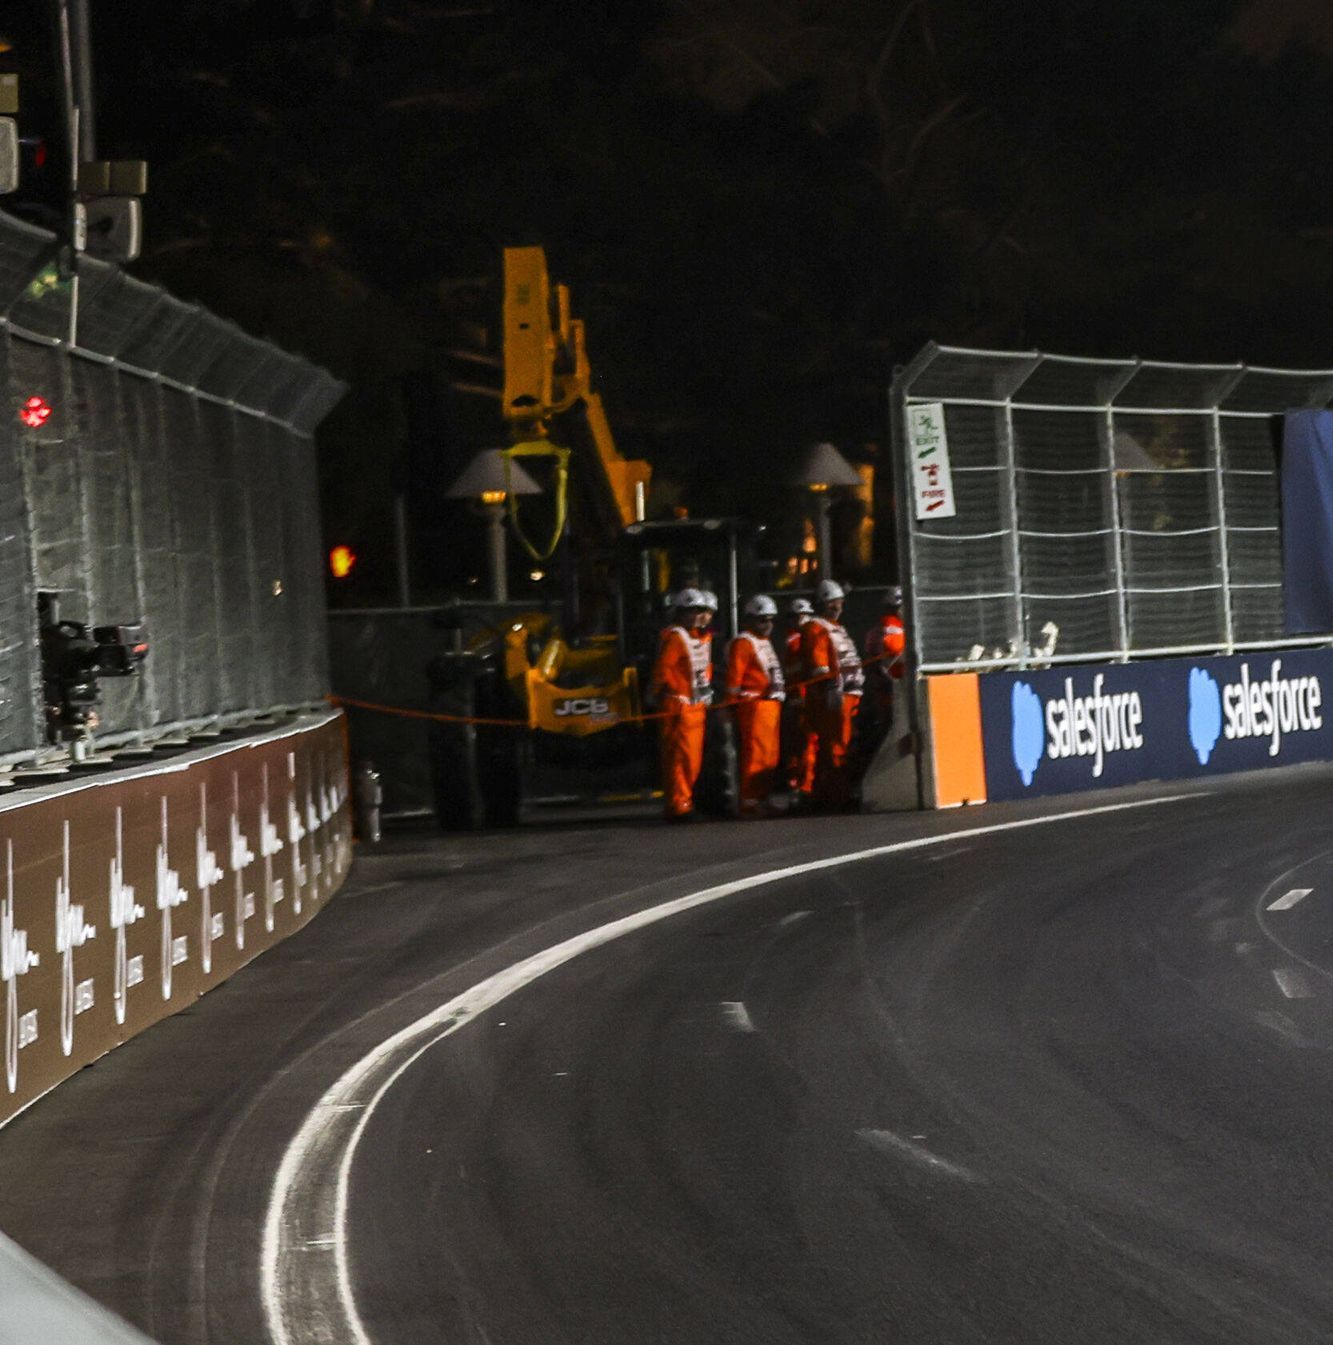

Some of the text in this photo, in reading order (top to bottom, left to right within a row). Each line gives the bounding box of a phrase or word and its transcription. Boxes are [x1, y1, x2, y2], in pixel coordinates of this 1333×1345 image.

[555, 698, 609, 716] JCB
[1045, 673, 1143, 778] salesforce
[1222, 658, 1323, 757] salesforce
